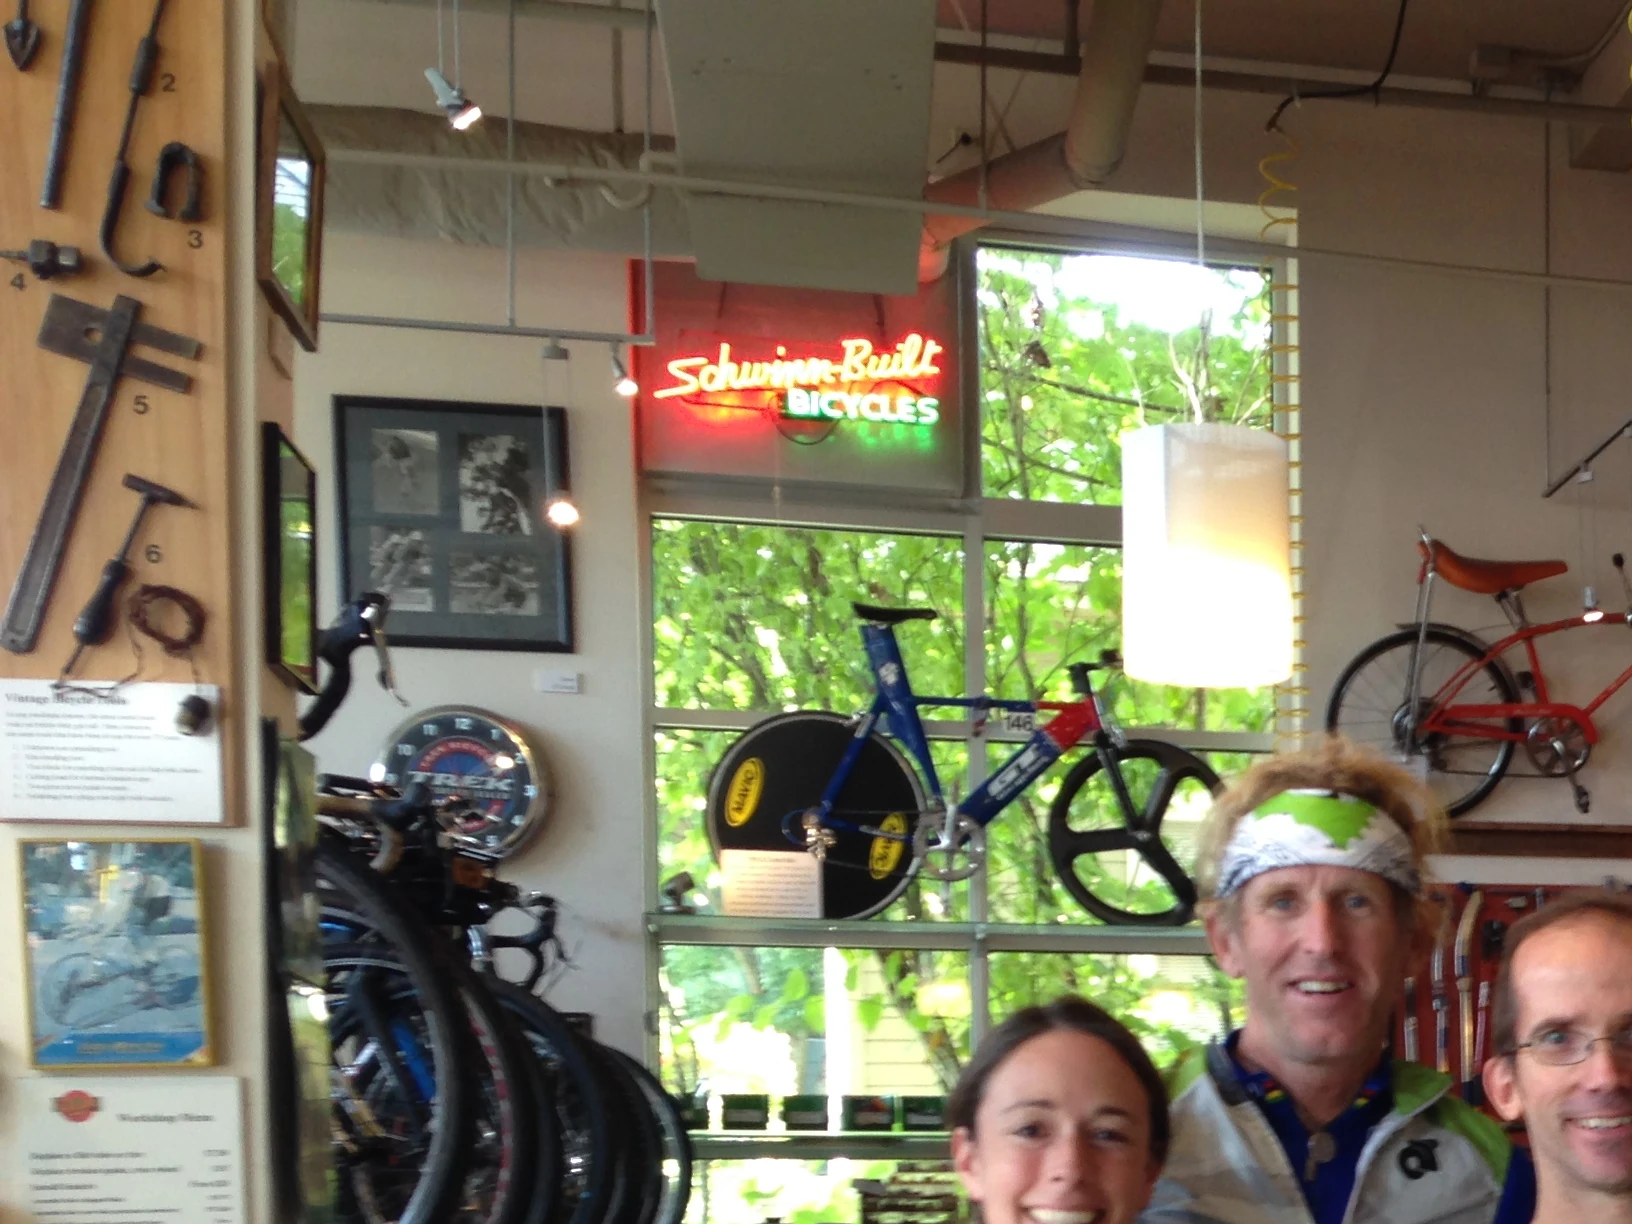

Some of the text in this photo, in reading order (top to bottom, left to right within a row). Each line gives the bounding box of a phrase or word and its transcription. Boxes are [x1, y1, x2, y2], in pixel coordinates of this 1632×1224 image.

[162, 73, 176, 92] 2
[188, 230, 203, 249] 3
[10, 273, 27, 291] 4
[133, 395, 149, 415] 5
[787, 387, 941, 426] BICYCLES
[145, 545, 162, 563] 6
[5, 691, 50, 705] Vintage
[455, 717, 473, 730] 12
[1005, 713, 1034, 732] 146
[397, 743, 416, 756] 10
[407, 771, 515, 791] TREK
[732, 768, 758, 815] MAVIC
